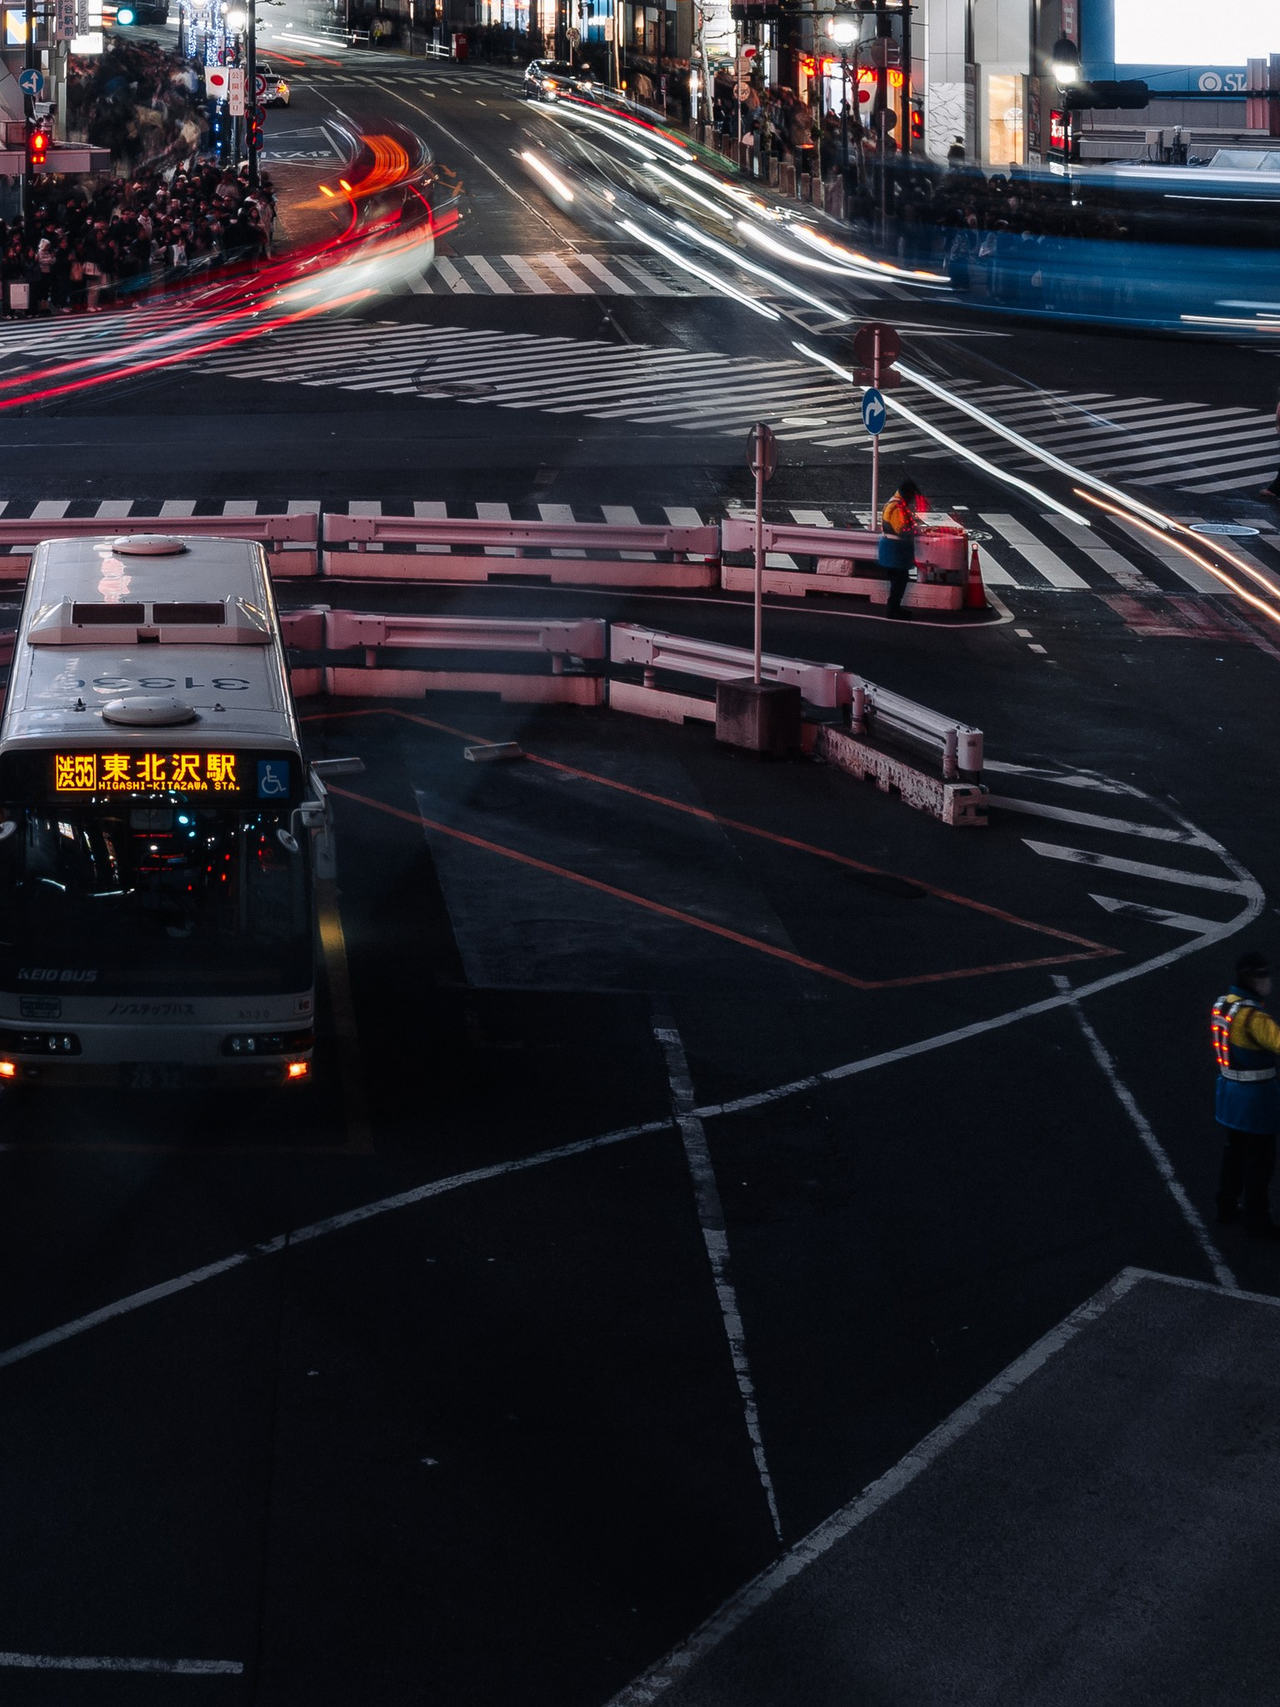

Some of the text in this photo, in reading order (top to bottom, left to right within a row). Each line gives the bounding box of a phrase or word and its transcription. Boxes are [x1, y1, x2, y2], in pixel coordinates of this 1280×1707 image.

[101, 753, 237, 782] 東北沢駅
[98, 780, 241, 791] HIGASHI-KITAZAWA STA.
[17, 968, 98, 982] KEIO BUS
